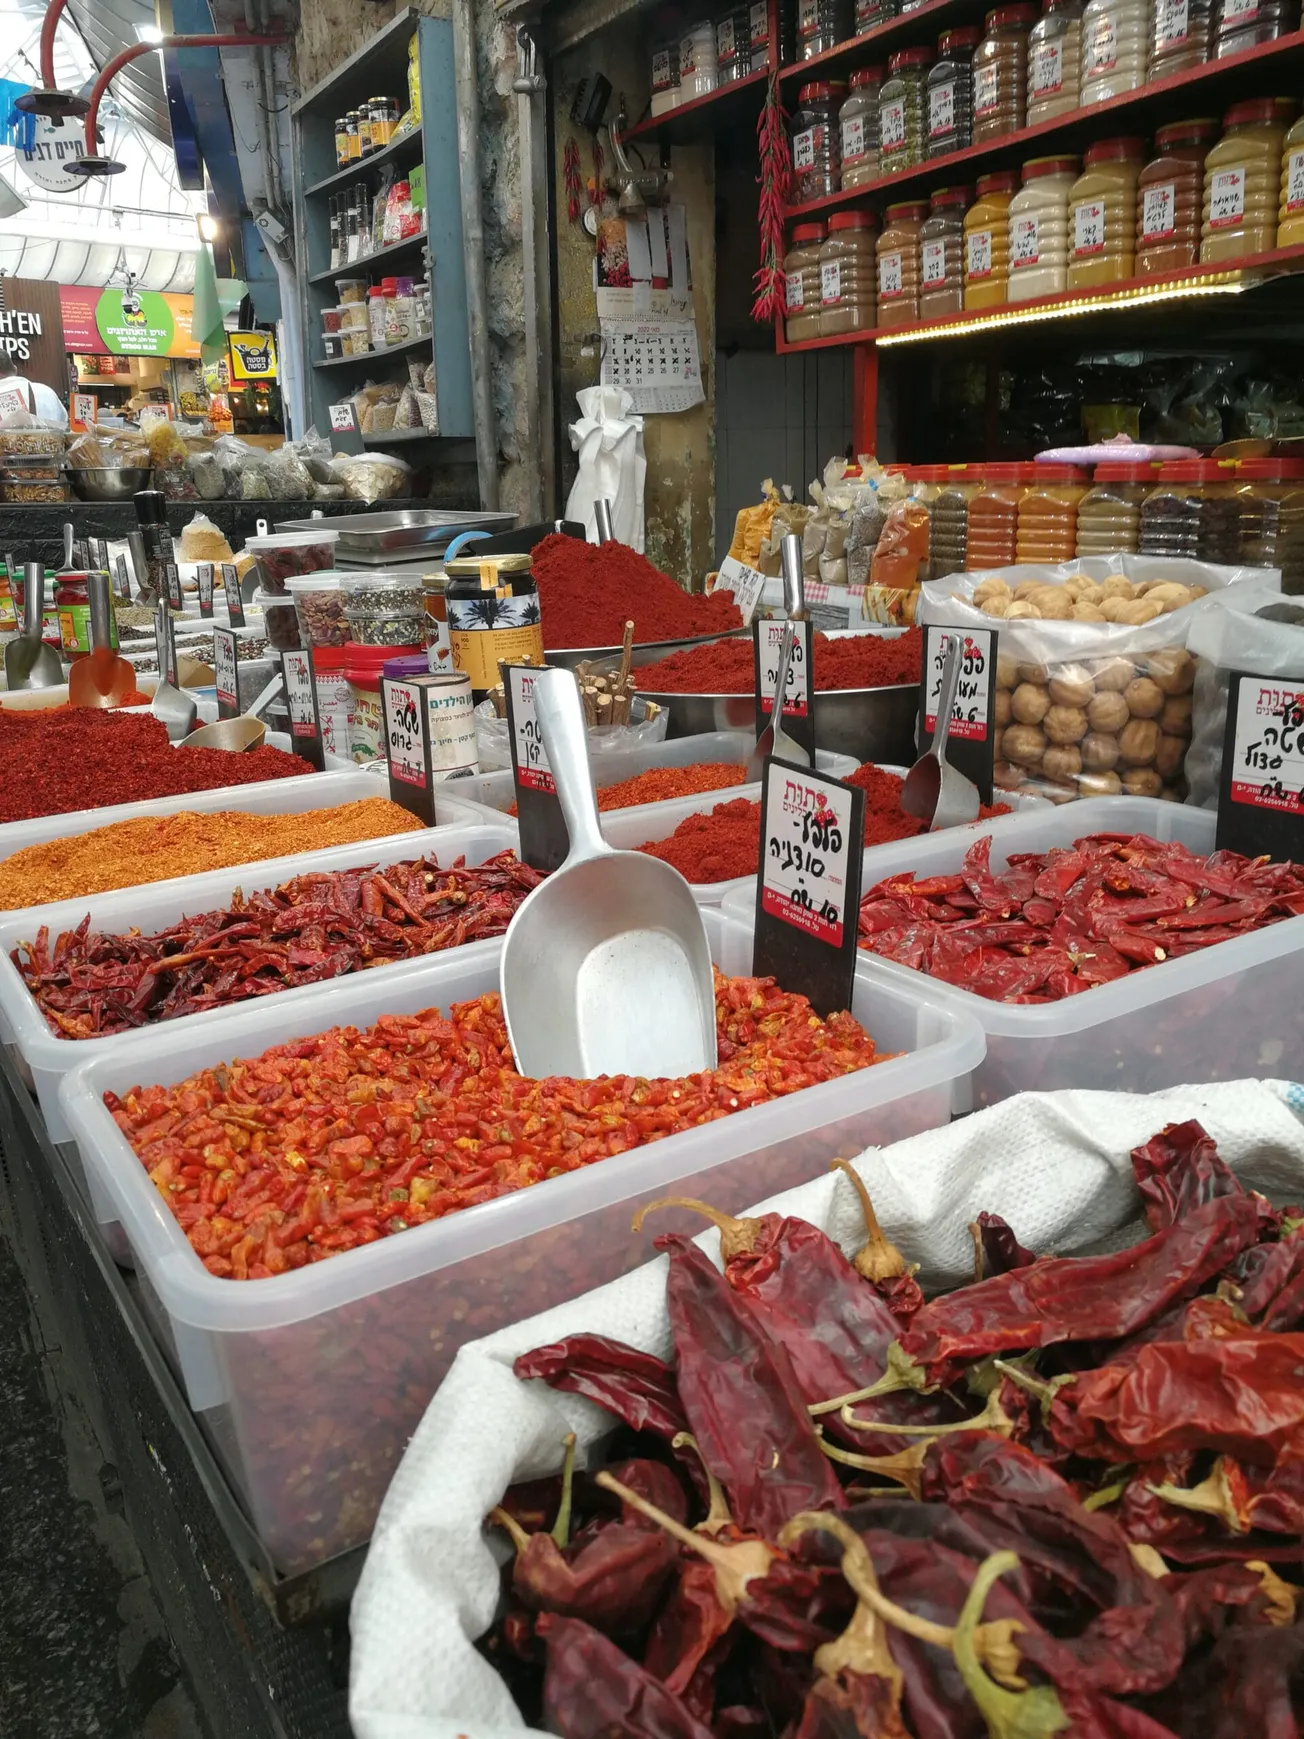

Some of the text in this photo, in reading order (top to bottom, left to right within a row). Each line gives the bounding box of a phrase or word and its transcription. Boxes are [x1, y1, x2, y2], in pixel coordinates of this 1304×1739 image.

[54, 140, 85, 160] חיים
[246, 356, 266, 364] פסטה
[647, 366, 654, 374] 25
[430, 695, 466, 709] הילדים
[1257, 688, 1294, 708] תות
[968, 706, 979, 723] 6
[784, 780, 815, 810] תות
[791, 877, 839, 924] 10 ש"ח
